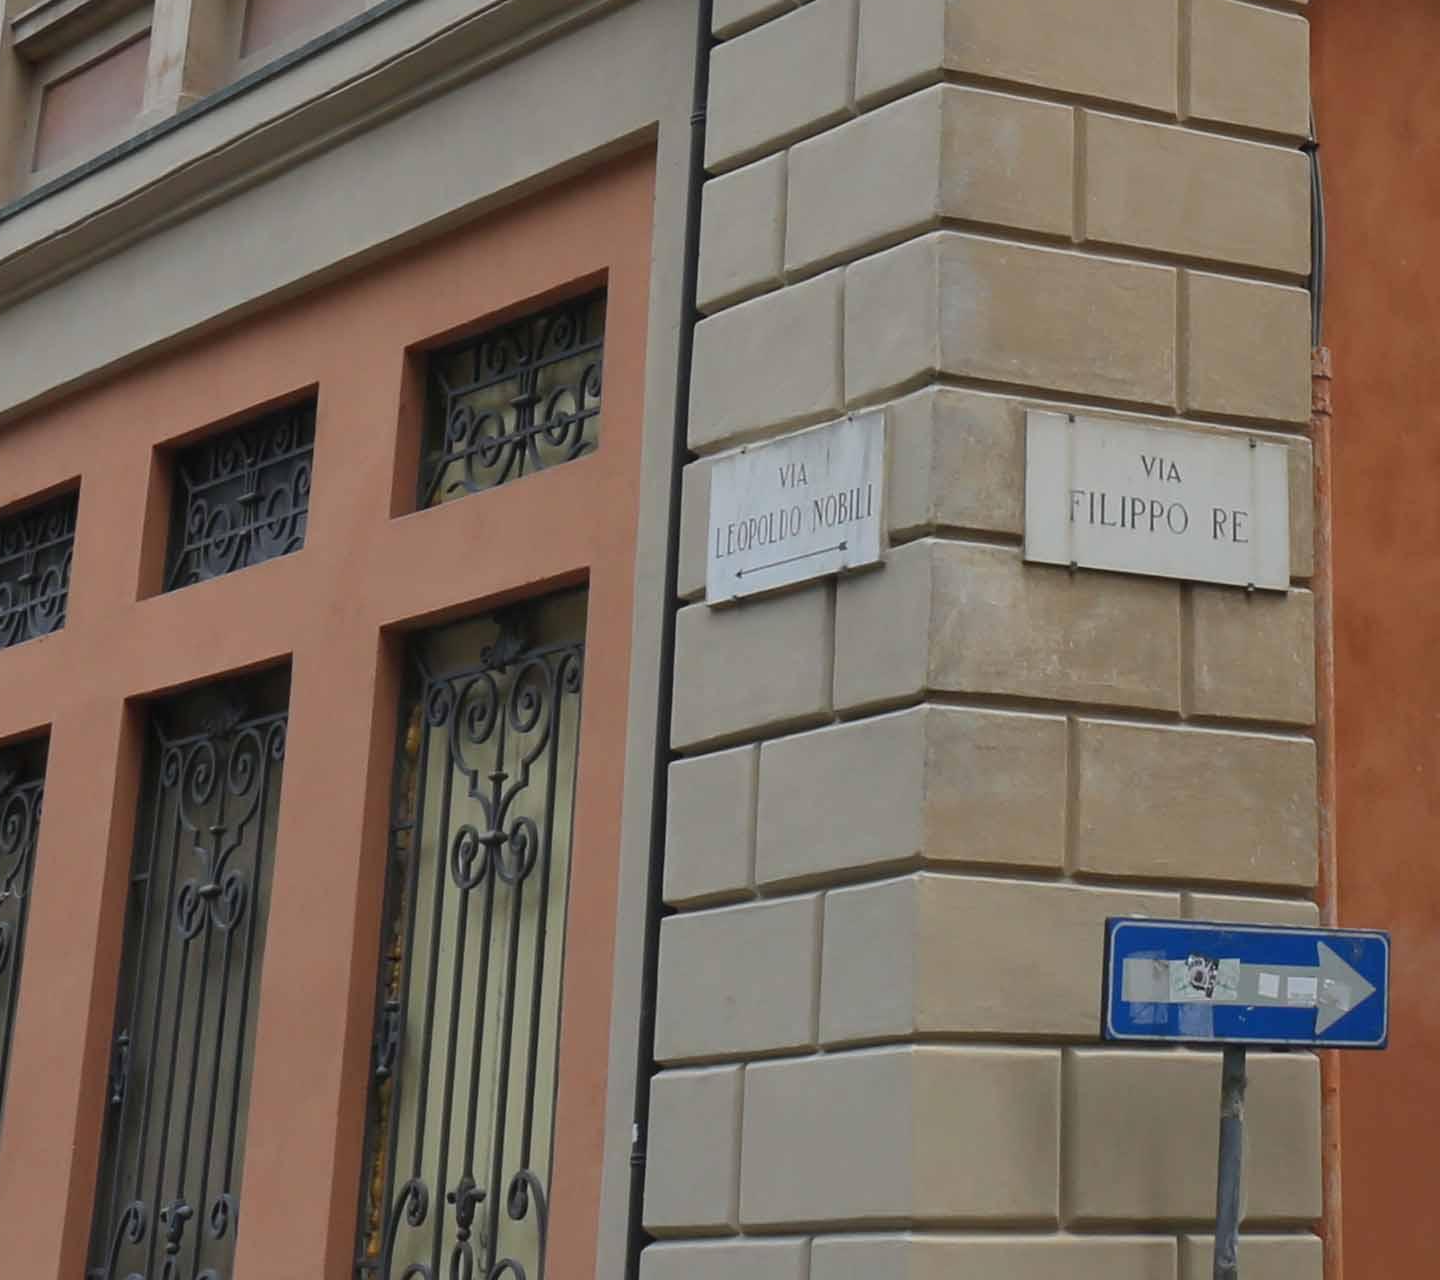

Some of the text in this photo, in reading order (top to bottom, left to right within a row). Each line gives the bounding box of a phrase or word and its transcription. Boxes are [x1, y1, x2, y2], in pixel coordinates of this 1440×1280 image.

[778, 462, 809, 489] VIA
[1140, 454, 1183, 484] VIA
[715, 483, 873, 560] LEOPOLDO NOBILI
[1069, 490, 1251, 545] FILIPPO RE
